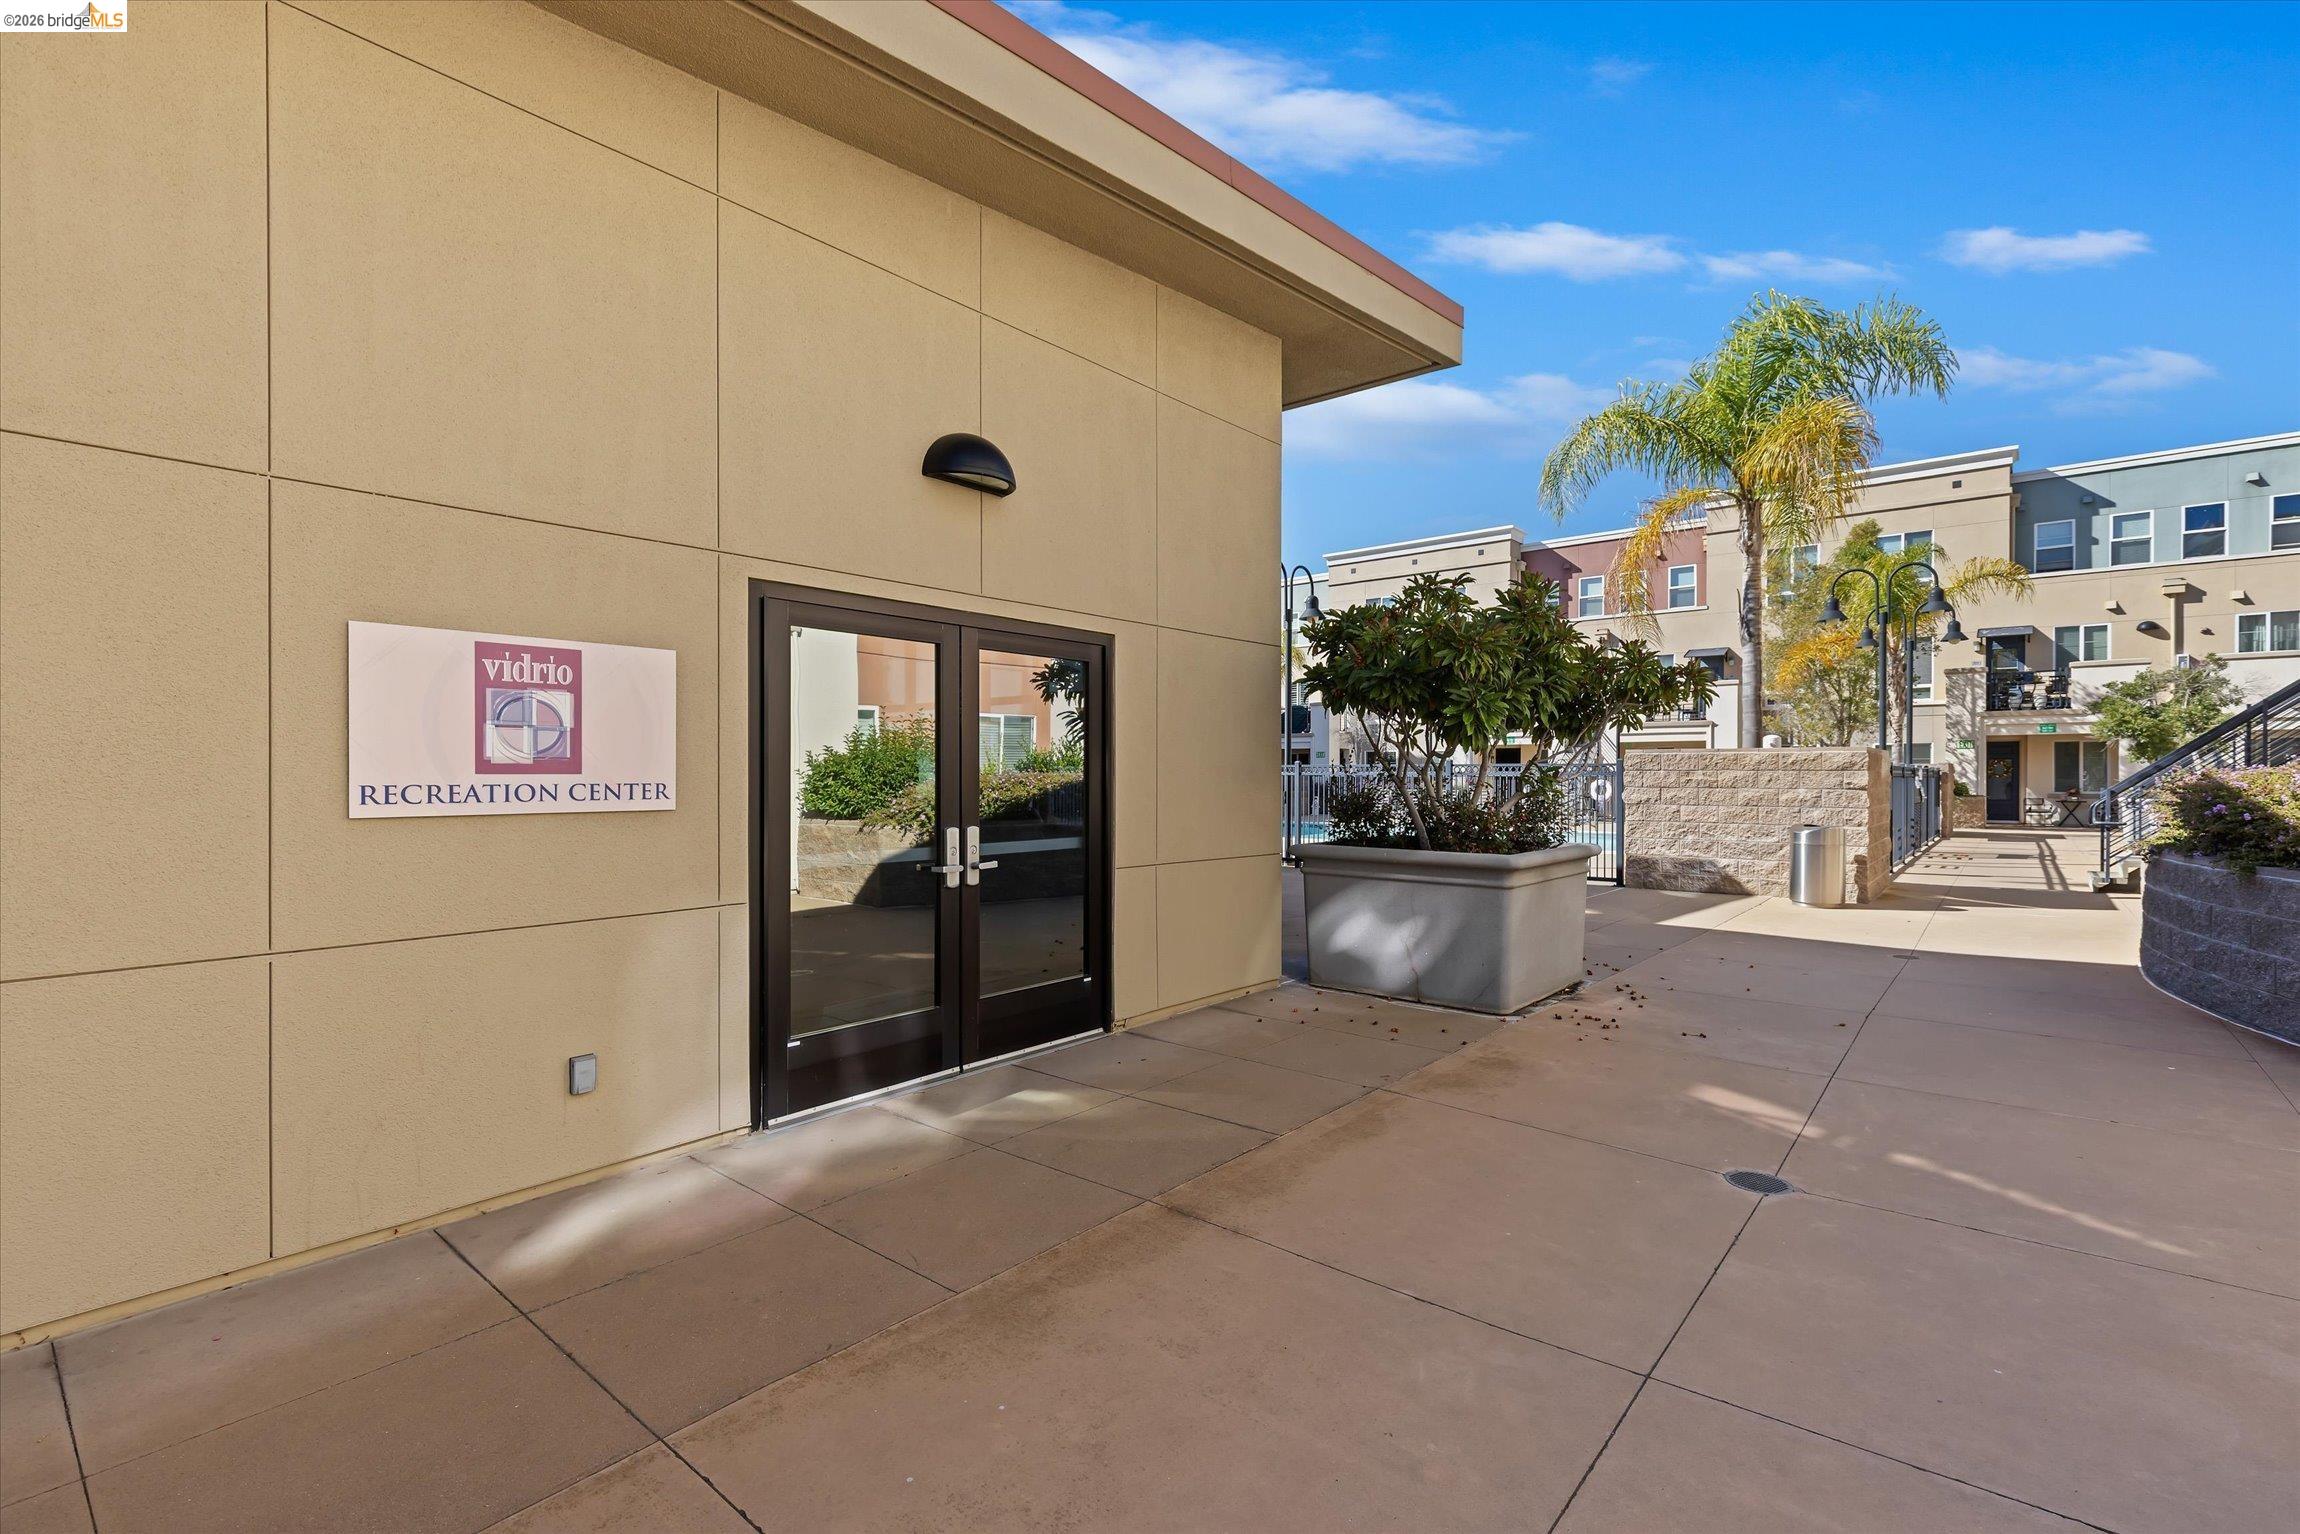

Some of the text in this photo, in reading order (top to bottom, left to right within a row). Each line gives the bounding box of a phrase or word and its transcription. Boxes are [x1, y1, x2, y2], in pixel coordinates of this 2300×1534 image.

[482, 651, 574, 686] vidrio
[358, 782, 672, 806] RECREATION CENTER
